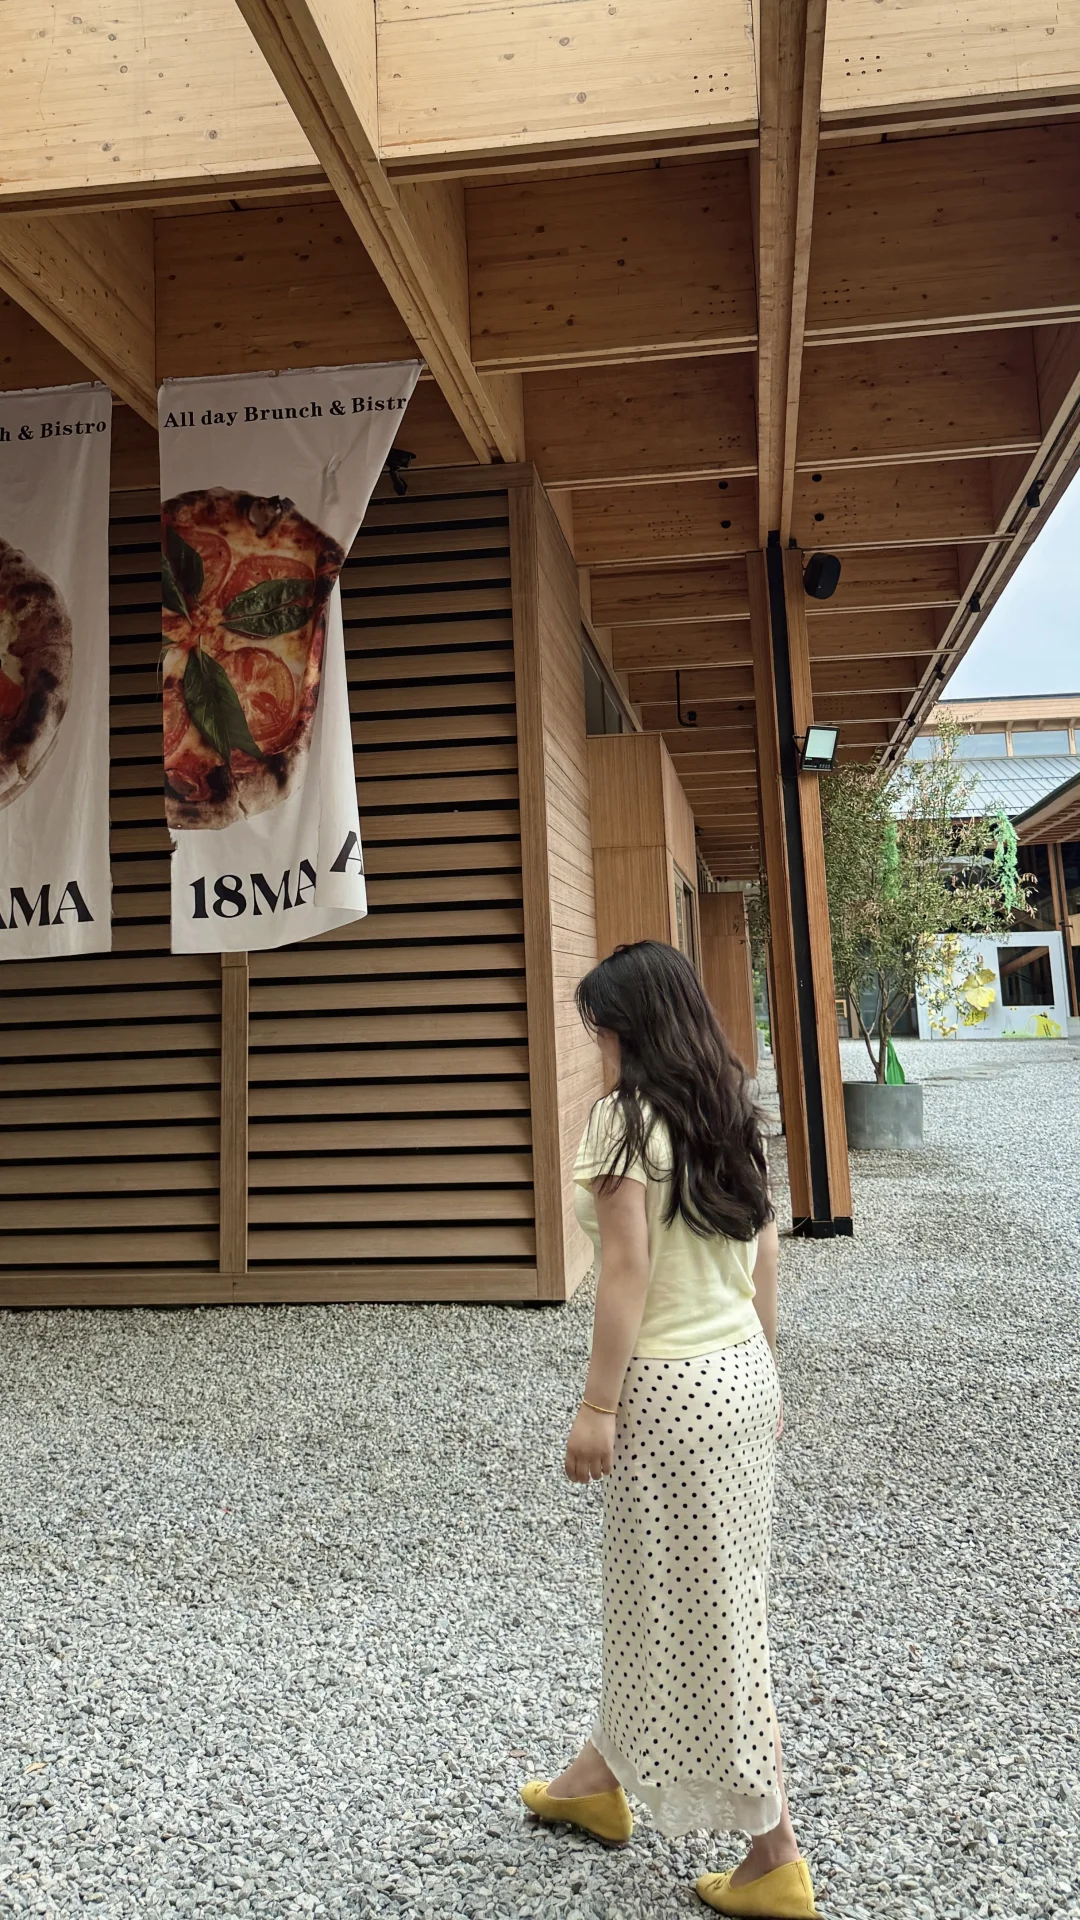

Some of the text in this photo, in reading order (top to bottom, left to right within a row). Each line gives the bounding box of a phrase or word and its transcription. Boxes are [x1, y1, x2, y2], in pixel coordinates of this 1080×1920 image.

[163, 412, 196, 428] All
[201, 409, 239, 427] day
[243, 401, 323, 422] Brunch
[329, 399, 346, 416] &
[18, 424, 34, 441] &
[39, 420, 107, 439] Bistro
